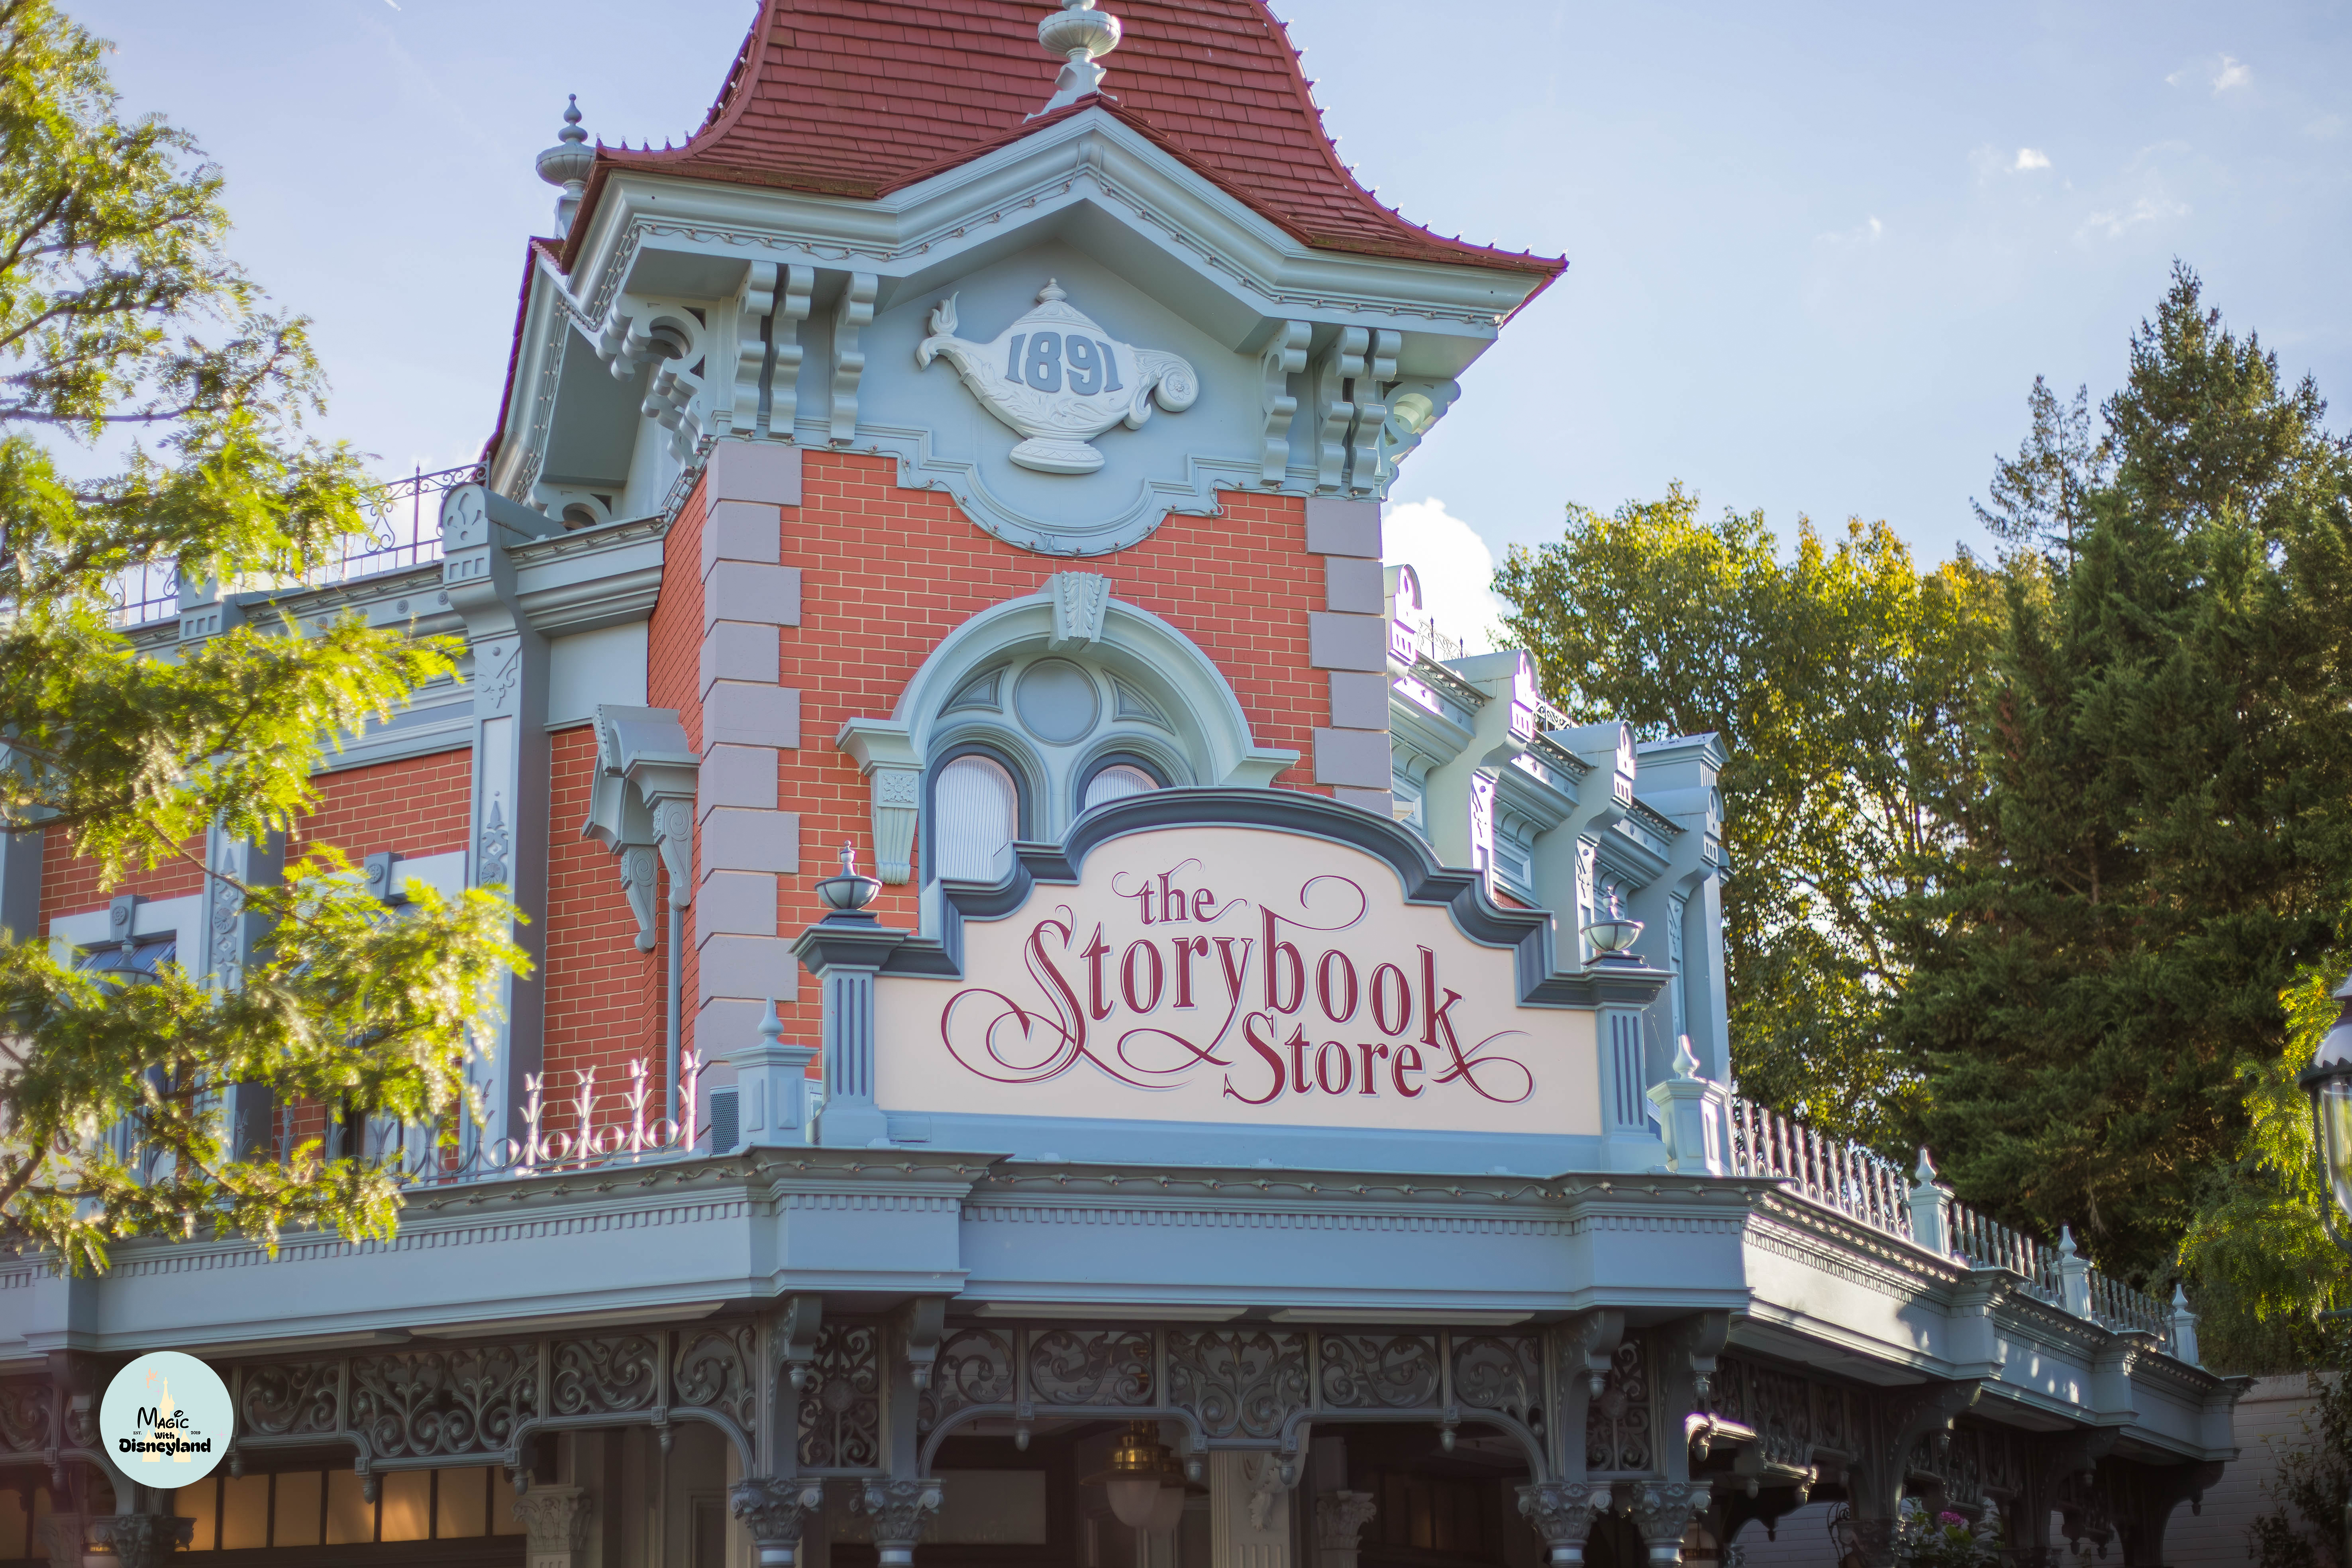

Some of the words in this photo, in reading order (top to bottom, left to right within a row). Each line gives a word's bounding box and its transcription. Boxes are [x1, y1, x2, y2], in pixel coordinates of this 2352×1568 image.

[1004, 332, 1123, 396] 1891
[1112, 858, 1248, 925] the
[941, 875, 1533, 1104] Storybook
[1223, 1011, 1424, 1105] Store
